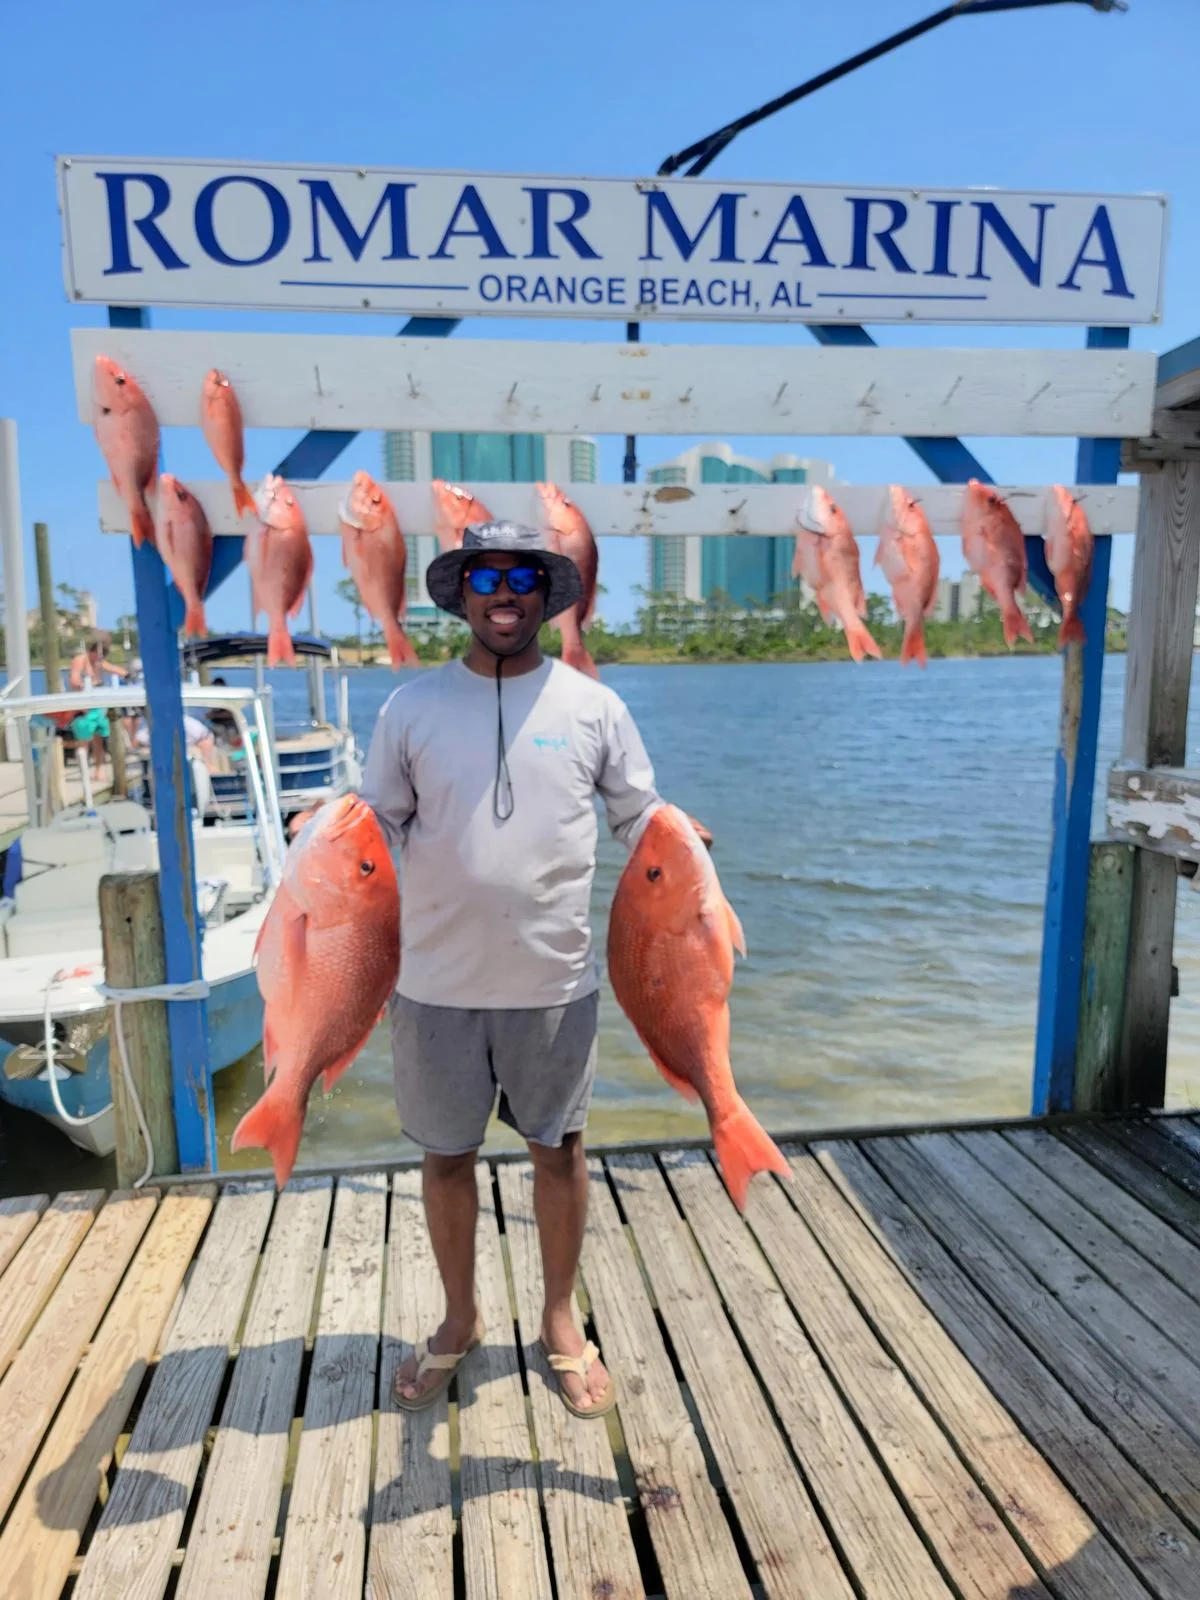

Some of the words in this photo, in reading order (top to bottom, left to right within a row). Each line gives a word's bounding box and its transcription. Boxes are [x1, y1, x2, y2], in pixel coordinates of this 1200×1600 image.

[95, 172, 603, 276] ROMAR
[638, 190, 1136, 300] MARINA
[479, 274, 627, 305] ORANGE
[639, 277, 761, 313] BEACH,
[771, 281, 813, 309] AL
